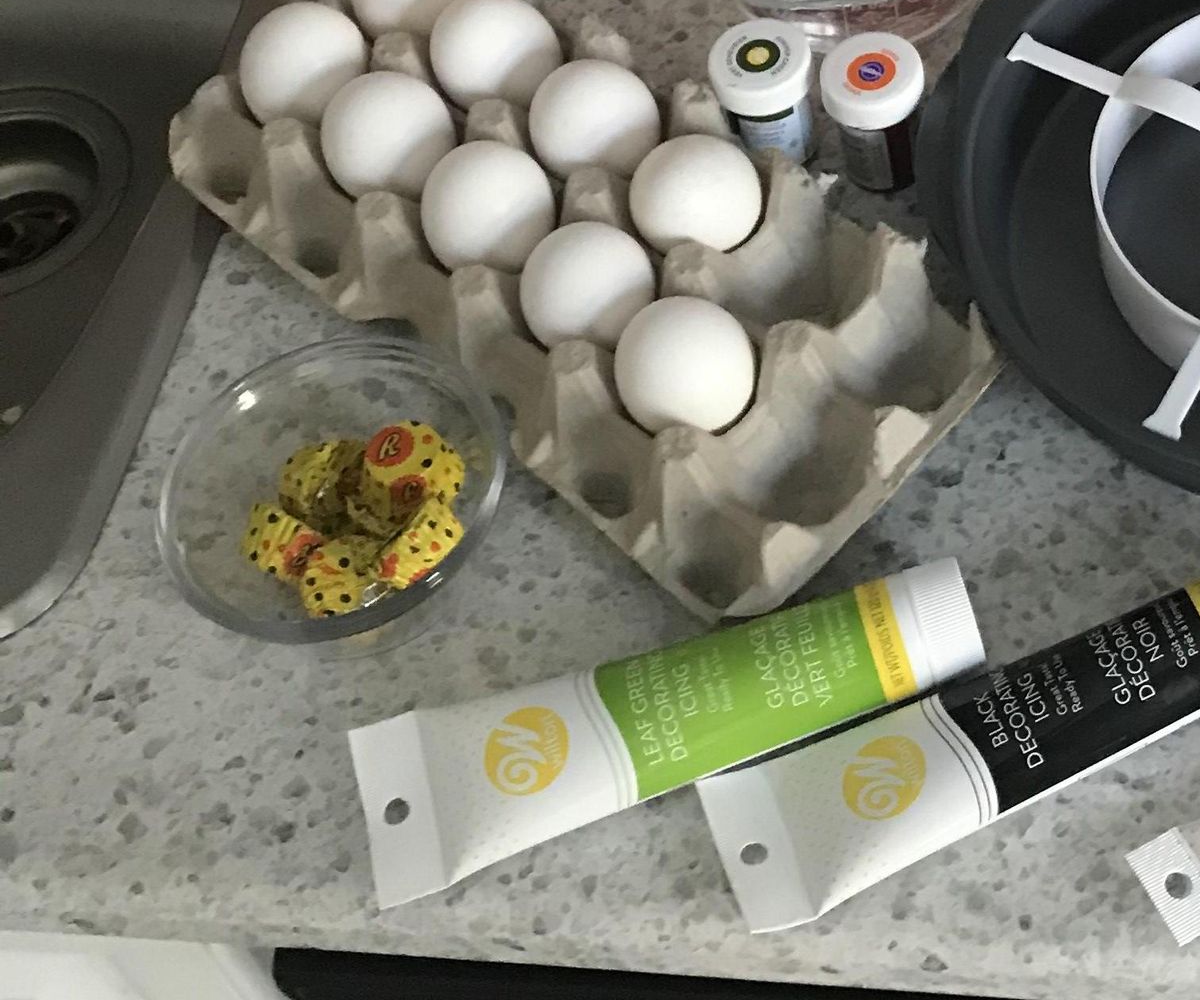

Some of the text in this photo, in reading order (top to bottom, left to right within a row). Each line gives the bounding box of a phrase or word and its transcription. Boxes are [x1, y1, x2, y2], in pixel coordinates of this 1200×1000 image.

[1132, 617, 1164, 663] NOIR
[1170, 639, 1188, 668] Goût
[1183, 632, 1199, 657] Prêt
[671, 663, 699, 718] ICING
[804, 659, 833, 709] VERT
[1057, 667, 1069, 681] To
[1086, 630, 1131, 705] GLAÇAGE
[627, 659, 665, 767] LEAF GREEN
[973, 691, 1009, 748] BLACK
[1017, 673, 1050, 723] ICING
[1050, 685, 1068, 715] Great
[1064, 679, 1084, 713] Ready
